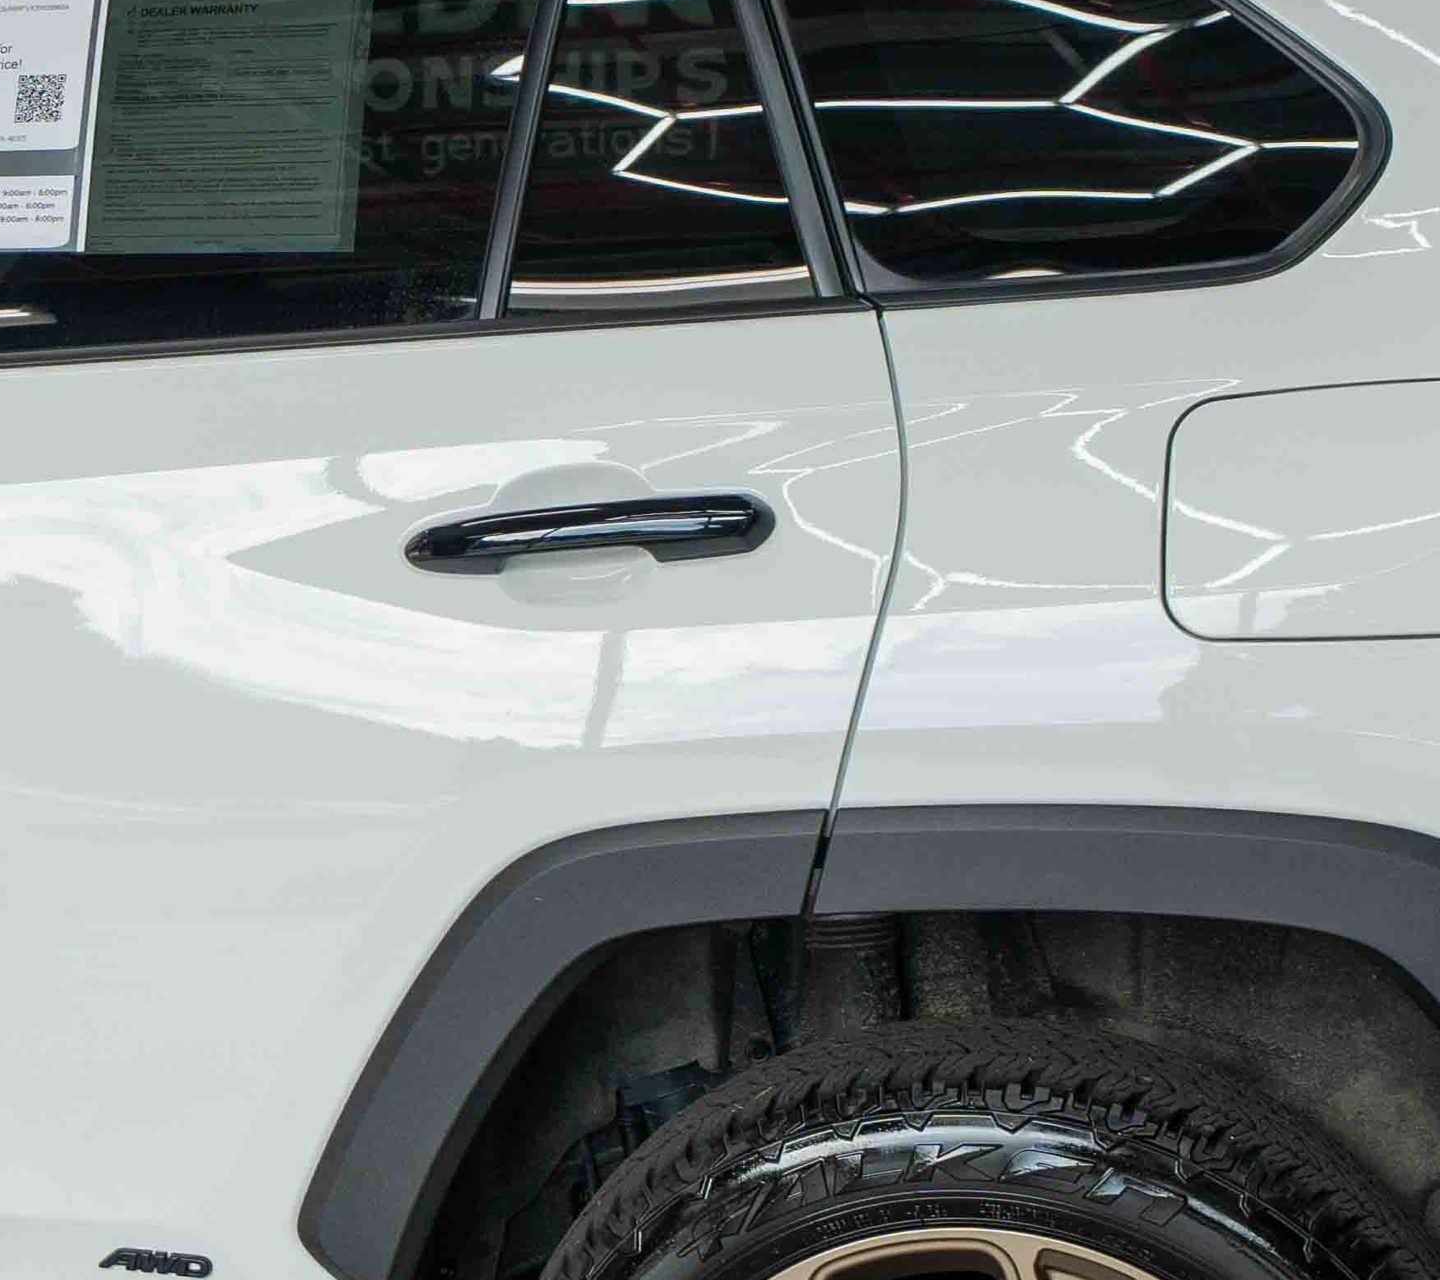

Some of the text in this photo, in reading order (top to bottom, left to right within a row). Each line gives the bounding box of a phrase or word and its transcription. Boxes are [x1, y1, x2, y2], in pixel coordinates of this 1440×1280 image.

[141, 4, 258, 18] DEALER WARRANTY
[673, 1143, 1188, 1261] FALKEN
[98, 1246, 213, 1279] AWD
